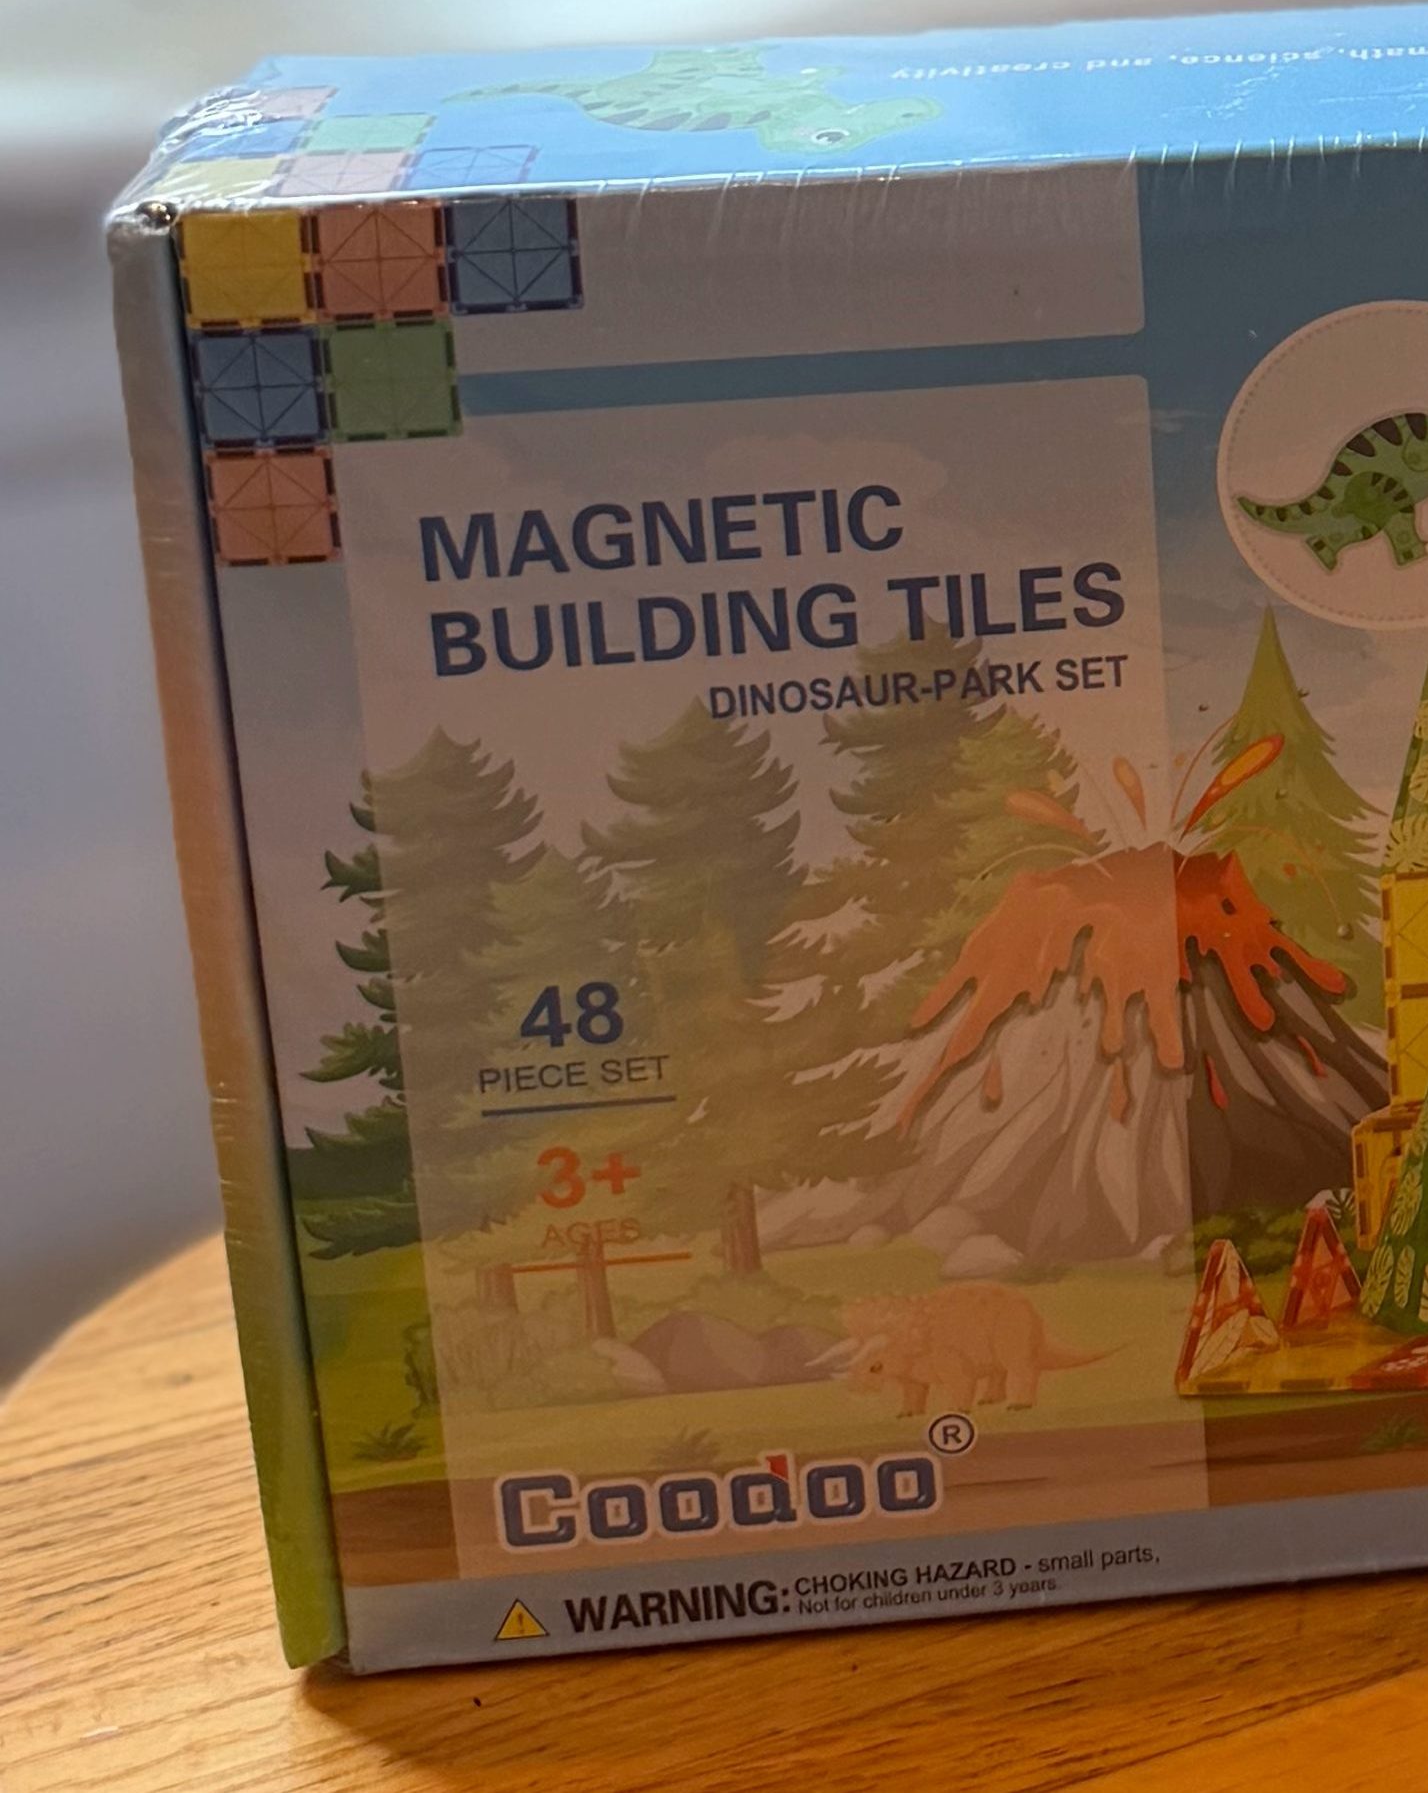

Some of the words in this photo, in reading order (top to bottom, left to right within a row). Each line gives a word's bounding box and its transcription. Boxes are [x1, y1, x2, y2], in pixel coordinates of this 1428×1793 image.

[890, 60, 1071, 80] creativity
[1086, 57, 1152, 71] and
[419, 484, 903, 582] MAGNETIC
[430, 582, 858, 677] BUILDING
[887, 561, 1126, 642] TILES
[709, 661, 1044, 719] DINOSAUR-PARK
[1055, 655, 1129, 691] SET
[520, 981, 624, 1047] 48
[479, 1061, 588, 1094] PIECE
[601, 1055, 669, 1084] SET
[537, 1146, 641, 1209] 3+
[541, 1218, 642, 1249] AGES
[795, 1568, 908, 1596] CHOKING
[916, 1557, 1016, 1584] HAZARD
[1038, 1550, 1094, 1573] small
[565, 1580, 790, 1633] WARNING:
[799, 1599, 830, 1616] Not
[834, 1597, 857, 1614] for
[863, 1590, 932, 1609] children
[938, 1584, 986, 1602] under
[993, 1582, 1003, 1596] 3
